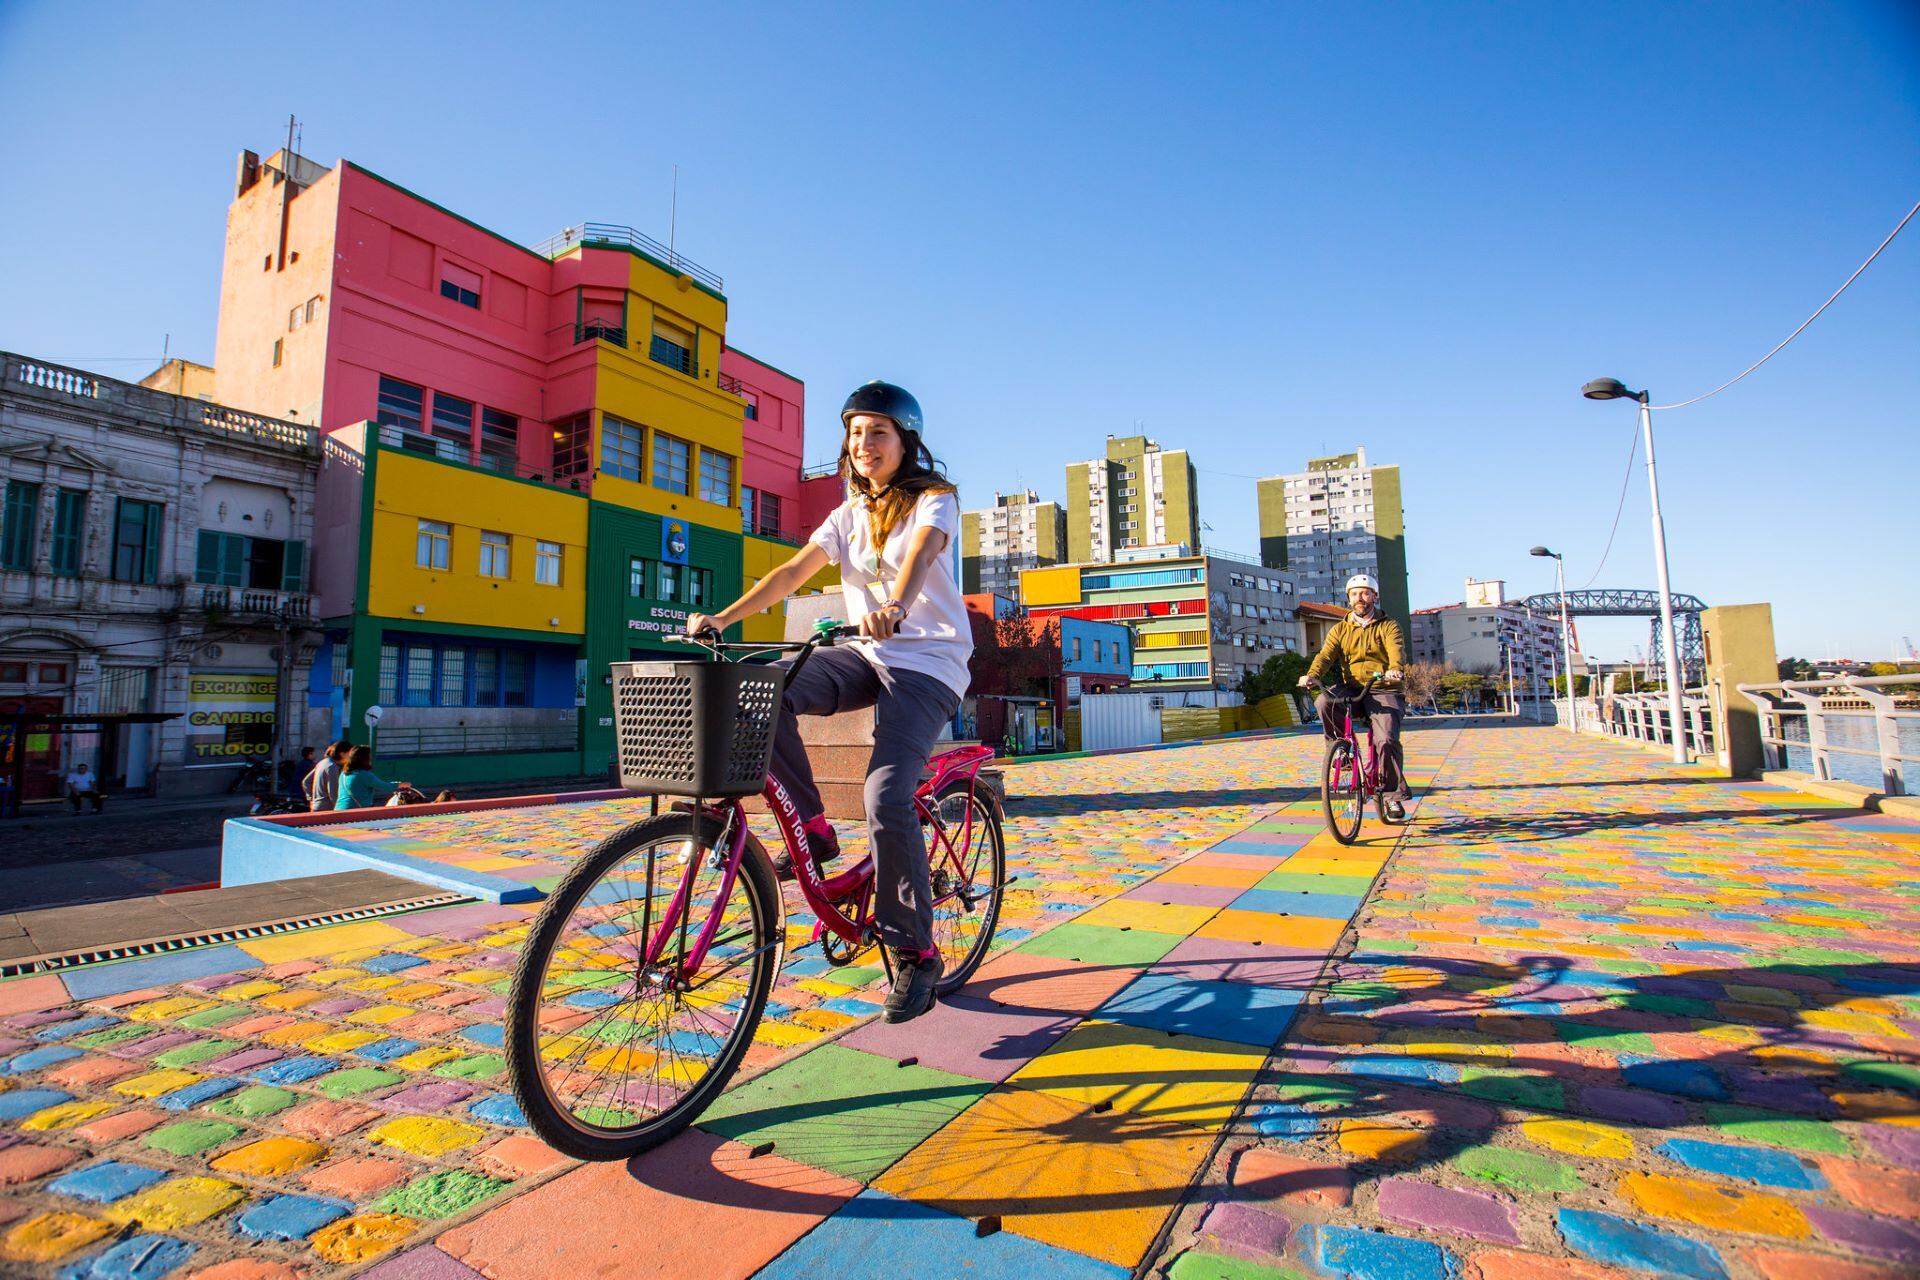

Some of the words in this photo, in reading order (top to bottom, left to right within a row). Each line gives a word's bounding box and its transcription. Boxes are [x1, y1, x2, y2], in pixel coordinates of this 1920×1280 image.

[650, 607, 688, 620] ESCUEL
[628, 619, 660, 631] PEDRO
[660, 623, 673, 633] DE
[191, 681, 277, 695] EXCHANGE
[190, 711, 276, 725] CAMBIO
[194, 743, 270, 757] TROCO
